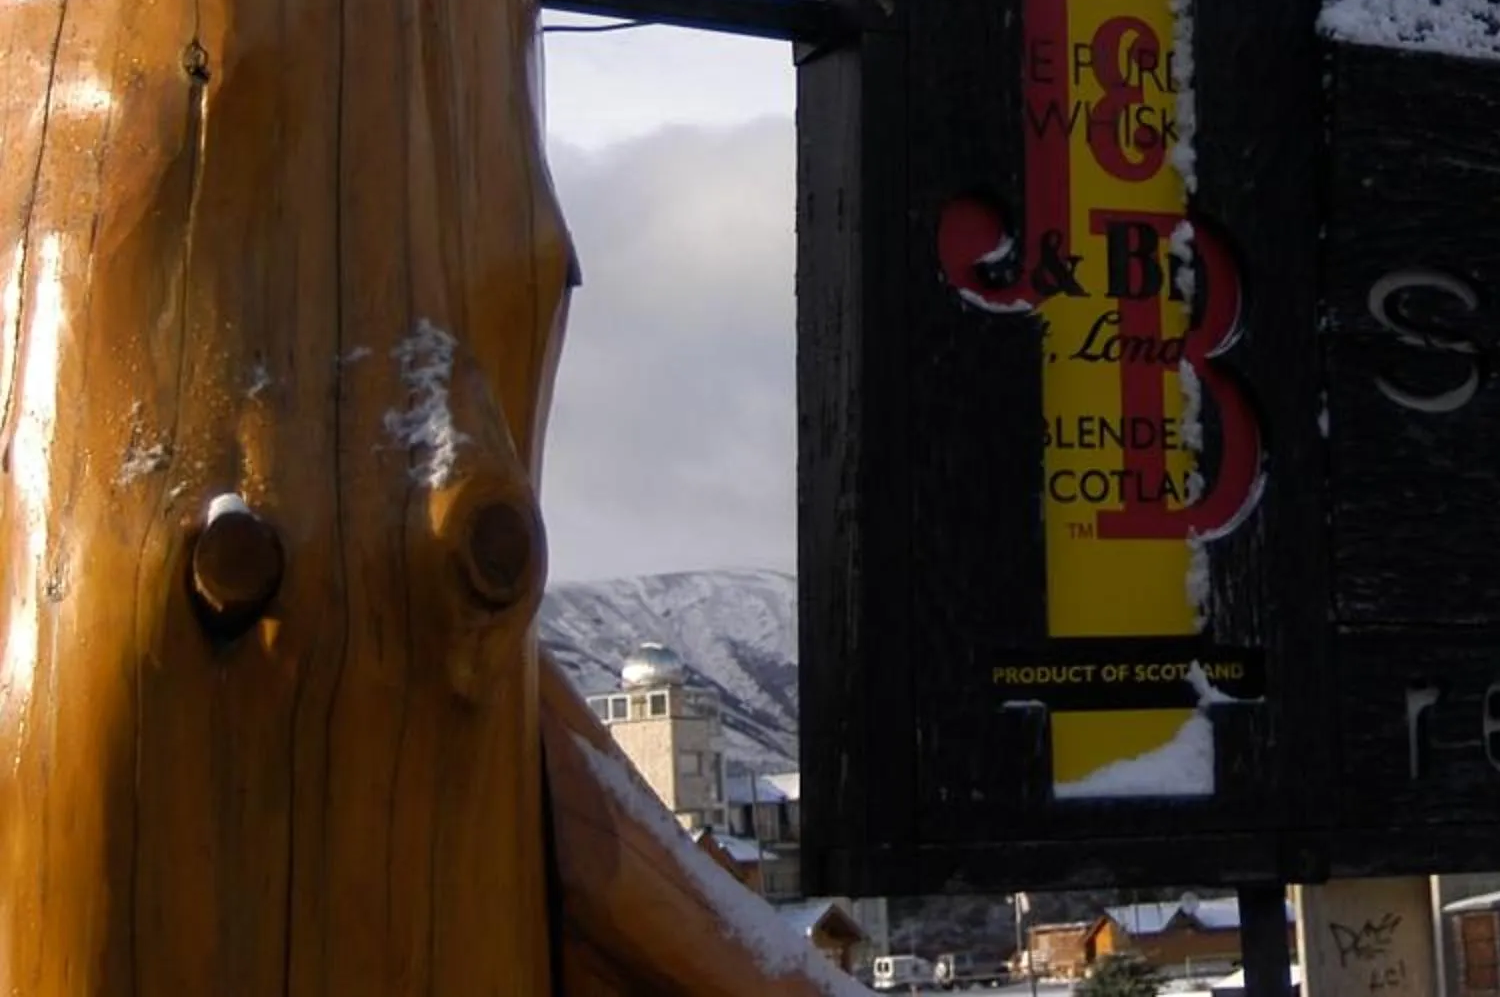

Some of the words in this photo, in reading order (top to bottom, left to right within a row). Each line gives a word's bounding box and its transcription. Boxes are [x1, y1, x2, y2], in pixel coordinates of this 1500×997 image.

[992, 664, 1097, 686] PRODUCT
[1100, 663, 1130, 684] OF
[1133, 661, 1247, 684] SCOTAND
